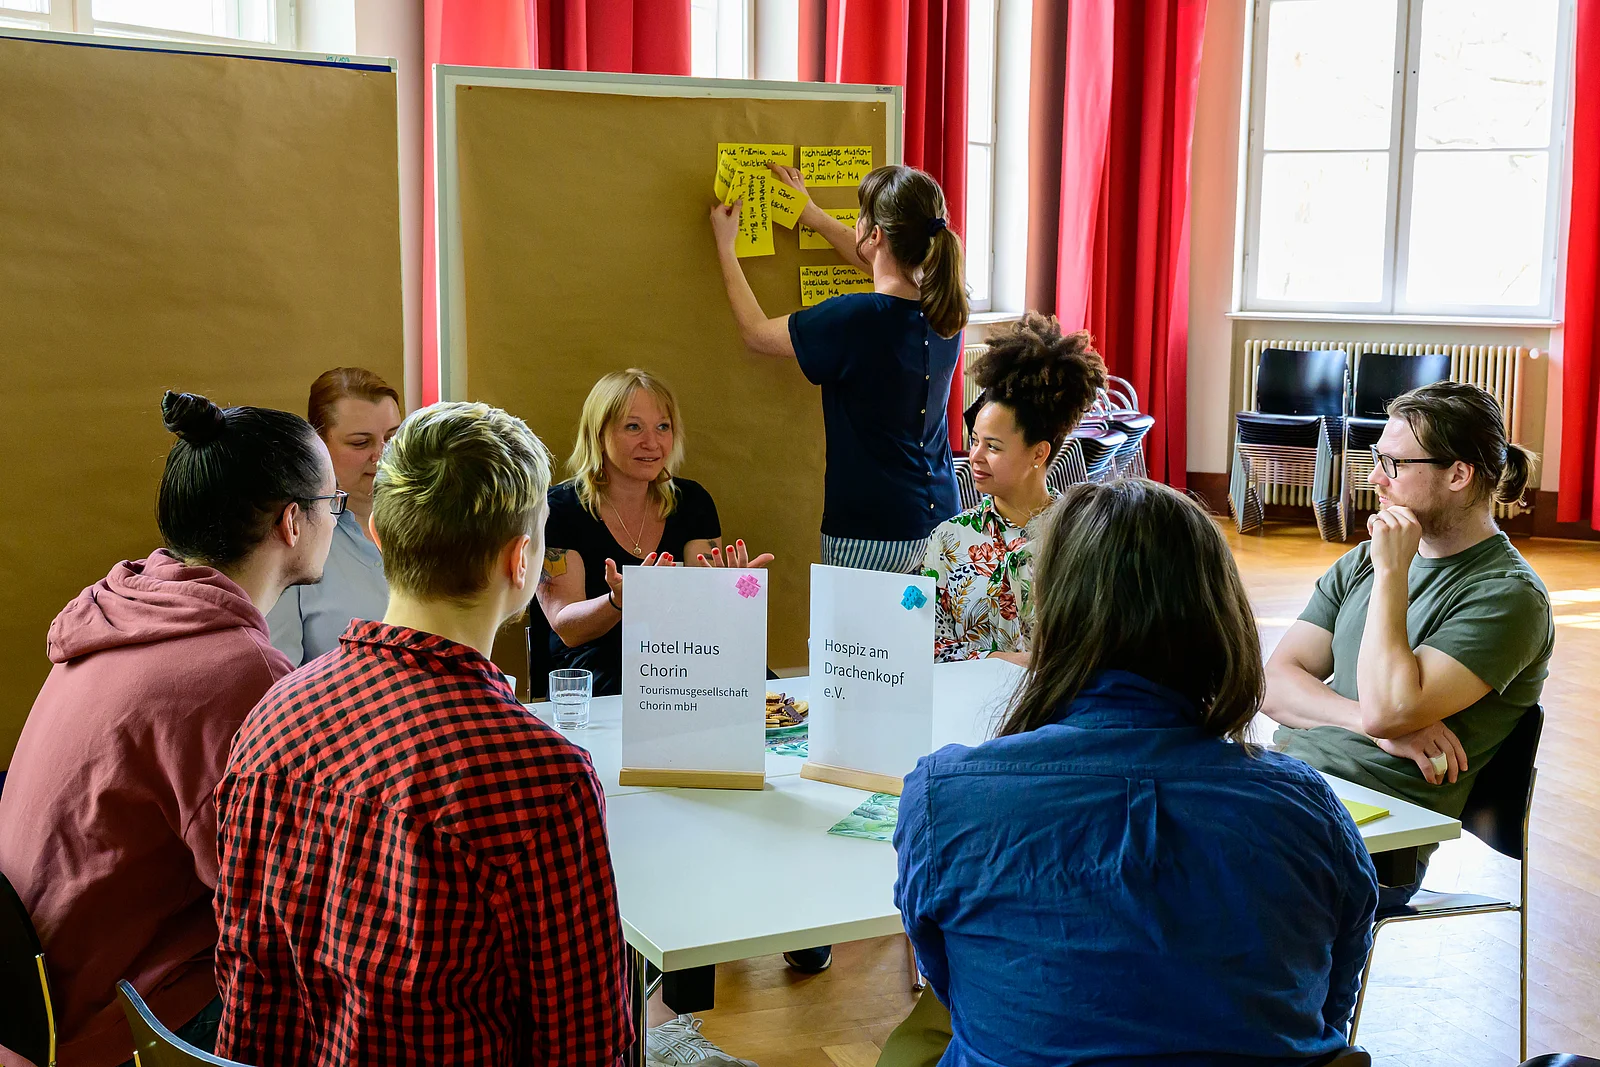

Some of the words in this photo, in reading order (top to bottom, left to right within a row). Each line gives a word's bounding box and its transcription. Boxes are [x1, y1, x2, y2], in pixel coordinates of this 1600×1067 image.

[771, 149, 788, 157] auch
[817, 158, 831, 172] für
[836, 170, 845, 184] für
[847, 171, 859, 181] MA
[778, 188, 796, 201] über
[770, 199, 794, 214] tschei-
[835, 212, 856, 220] auch
[750, 220, 759, 244] Blick
[802, 267, 828, 277] während
[803, 289, 813, 300] ung
[815, 288, 825, 296] bei
[828, 287, 840, 296] MA
[640, 640, 680, 655] Hotel
[683, 641, 720, 656] Haus
[824, 638, 866, 658] Hospiz
[869, 647, 889, 660] am
[639, 663, 688, 678] Chorin
[824, 661, 905, 687] Drachenkopf
[639, 684, 749, 699] Tourismusgesellschaft
[823, 686, 845, 700] e.V.
[639, 700, 672, 711] Chorin
[674, 701, 698, 712] mbH
